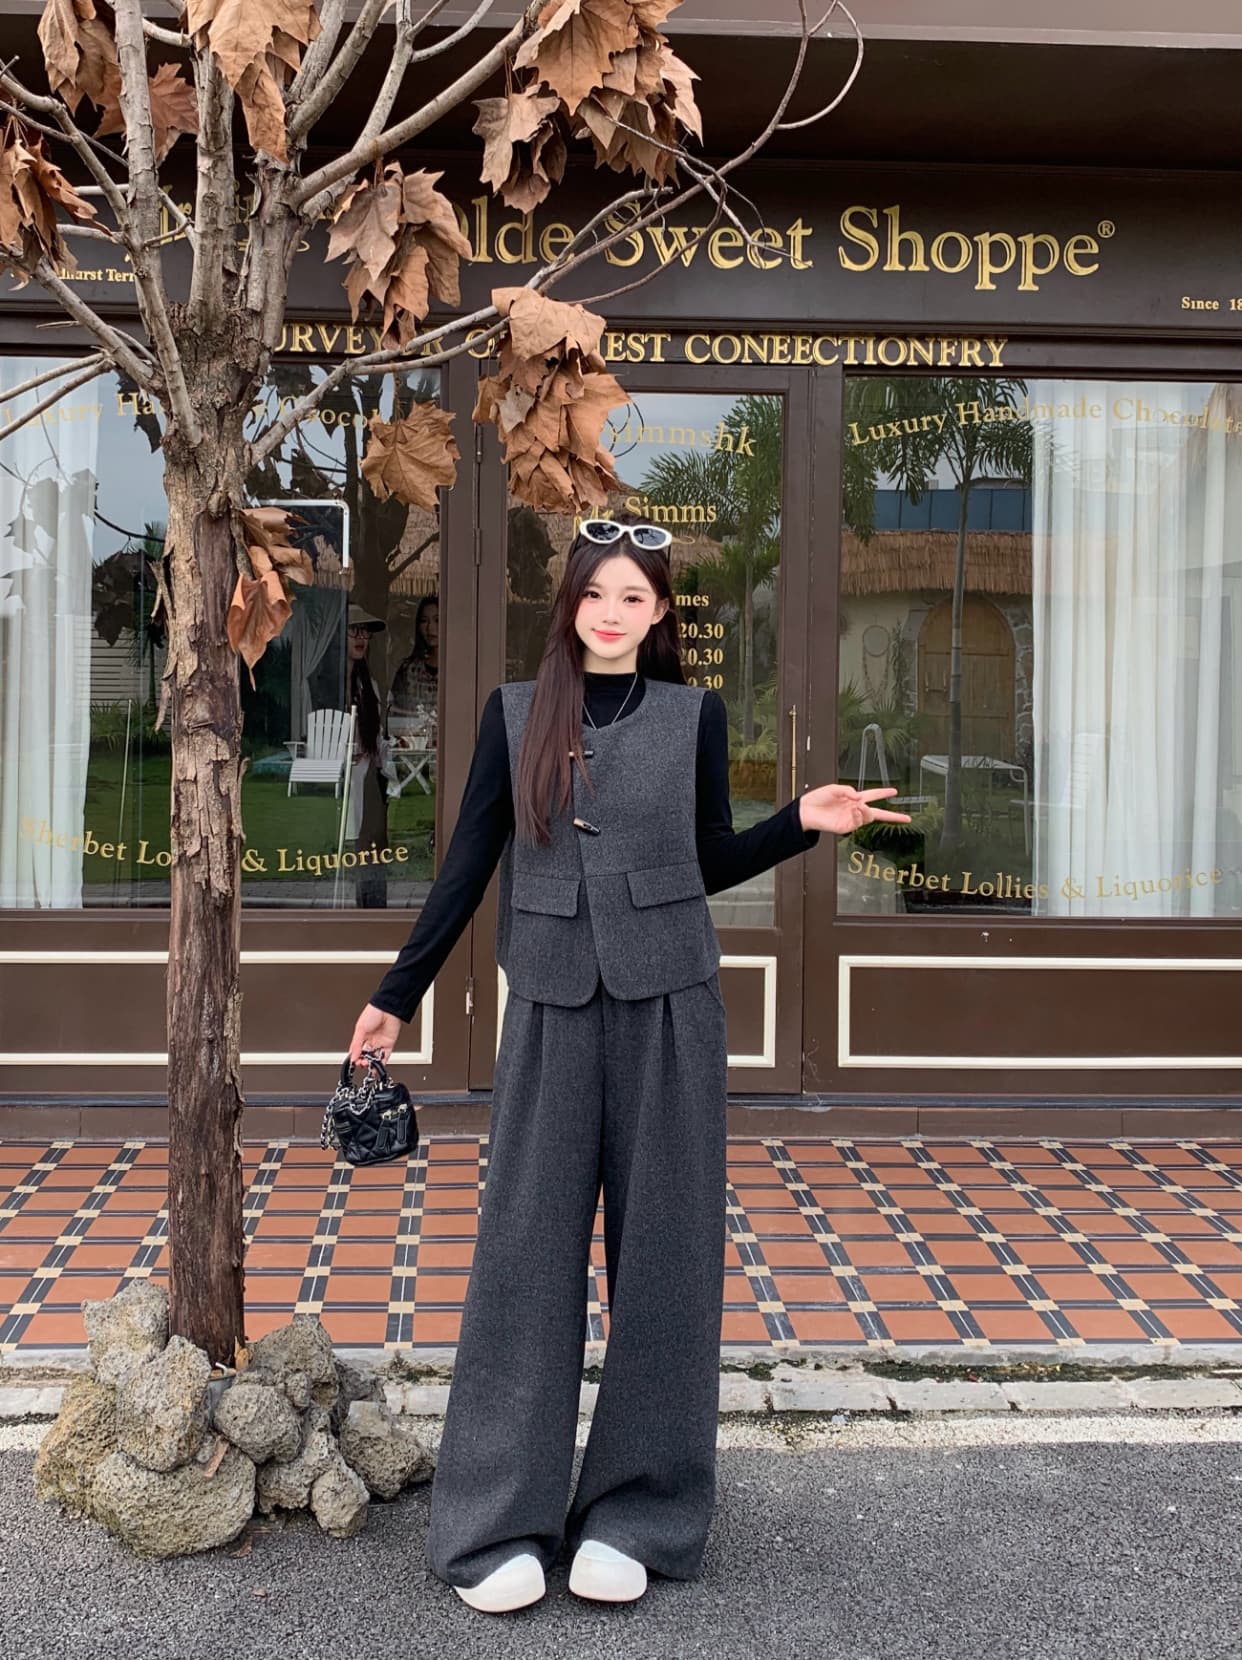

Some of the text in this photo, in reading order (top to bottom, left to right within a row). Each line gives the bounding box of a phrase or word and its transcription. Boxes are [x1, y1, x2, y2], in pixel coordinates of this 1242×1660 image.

[604, 201, 813, 270] Sweet
[1181, 296, 1219, 310] Since
[848, 410, 947, 446] Luxury
[956, 391, 1103, 428] Handmade
[626, 496, 717, 523] Simms
[675, 593, 710, 608] mes
[19, 815, 127, 861] Sherbet
[241, 848, 268, 872] &
[277, 842, 409, 876] Liquorice
[847, 850, 1224, 902] Sherbet Lollies & Liquorice
